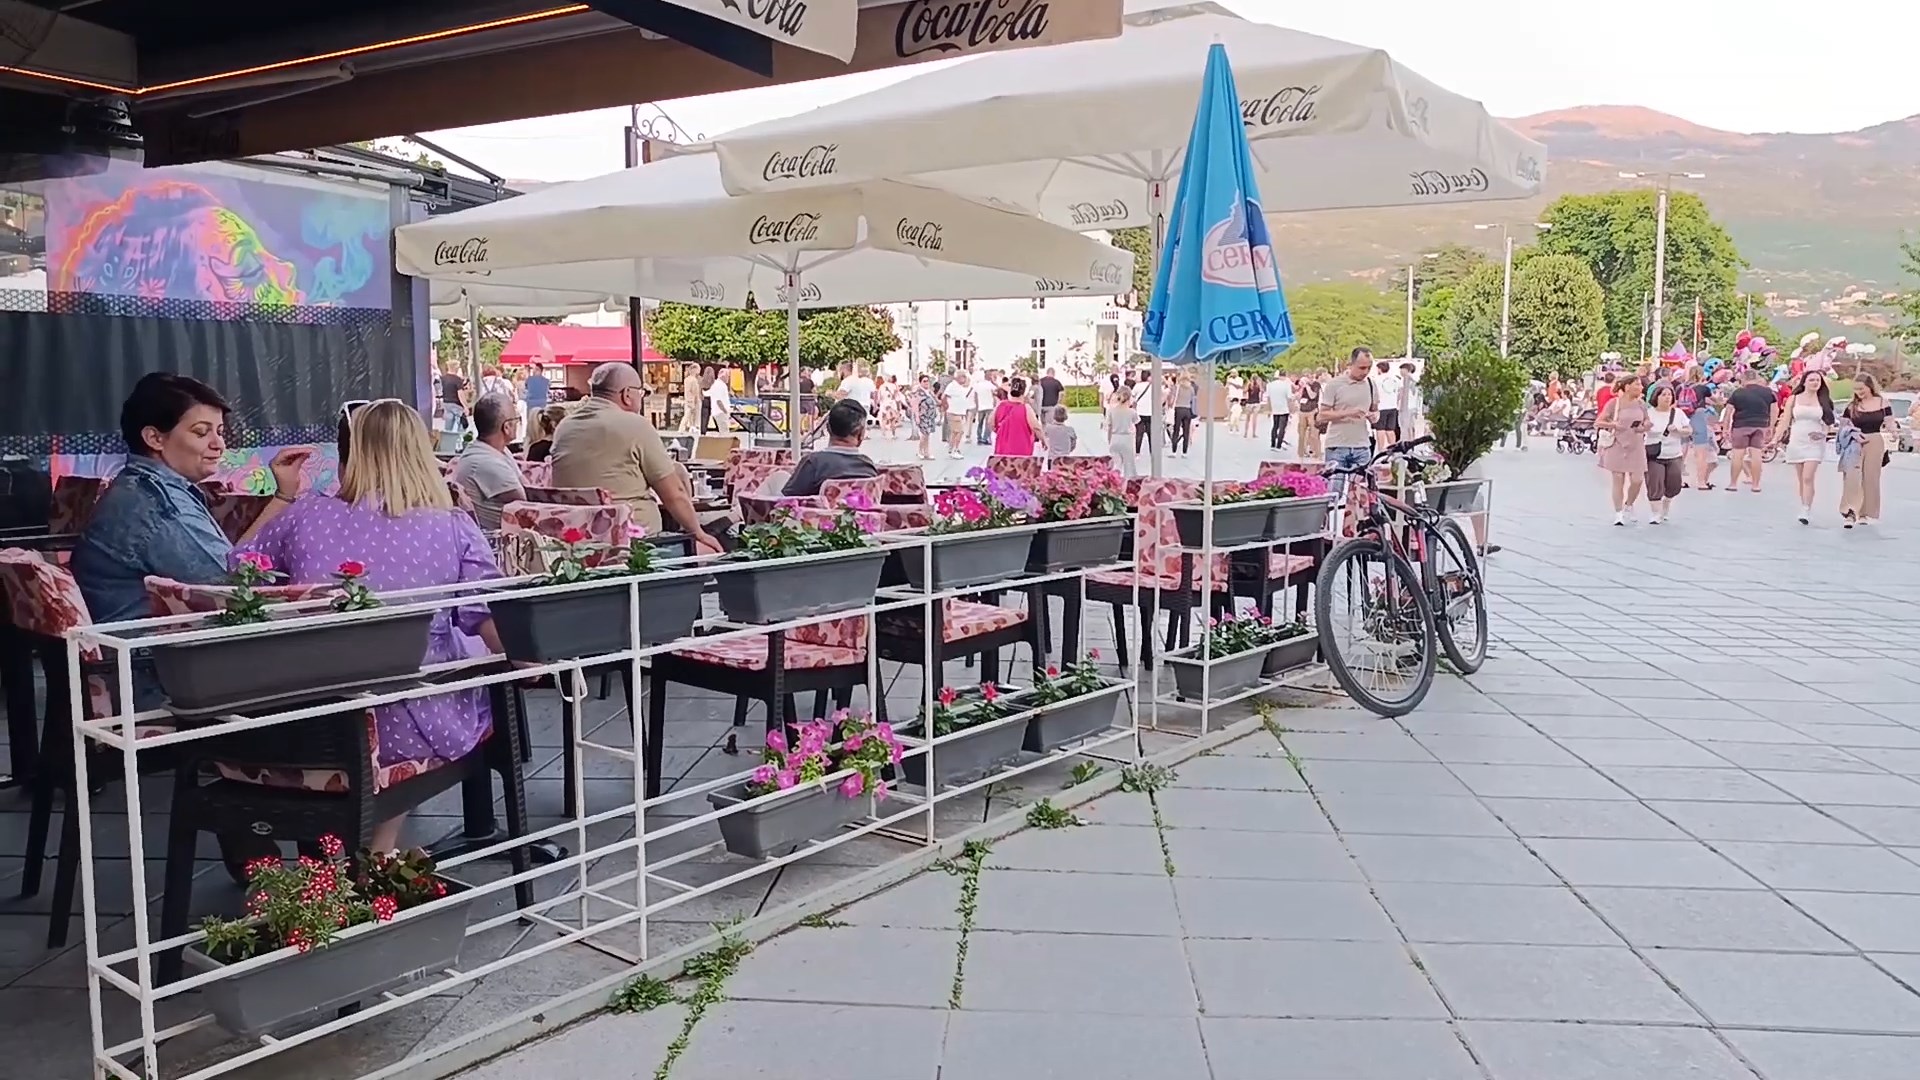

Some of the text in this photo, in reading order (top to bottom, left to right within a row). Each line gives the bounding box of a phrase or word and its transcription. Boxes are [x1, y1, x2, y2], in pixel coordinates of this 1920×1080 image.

[763, 143, 840, 182] Coca-Cola
[749, 213, 823, 245] Coca-Cola
[896, 217, 944, 252] Coca-Cola
[434, 237, 489, 266] Coca-Cola
